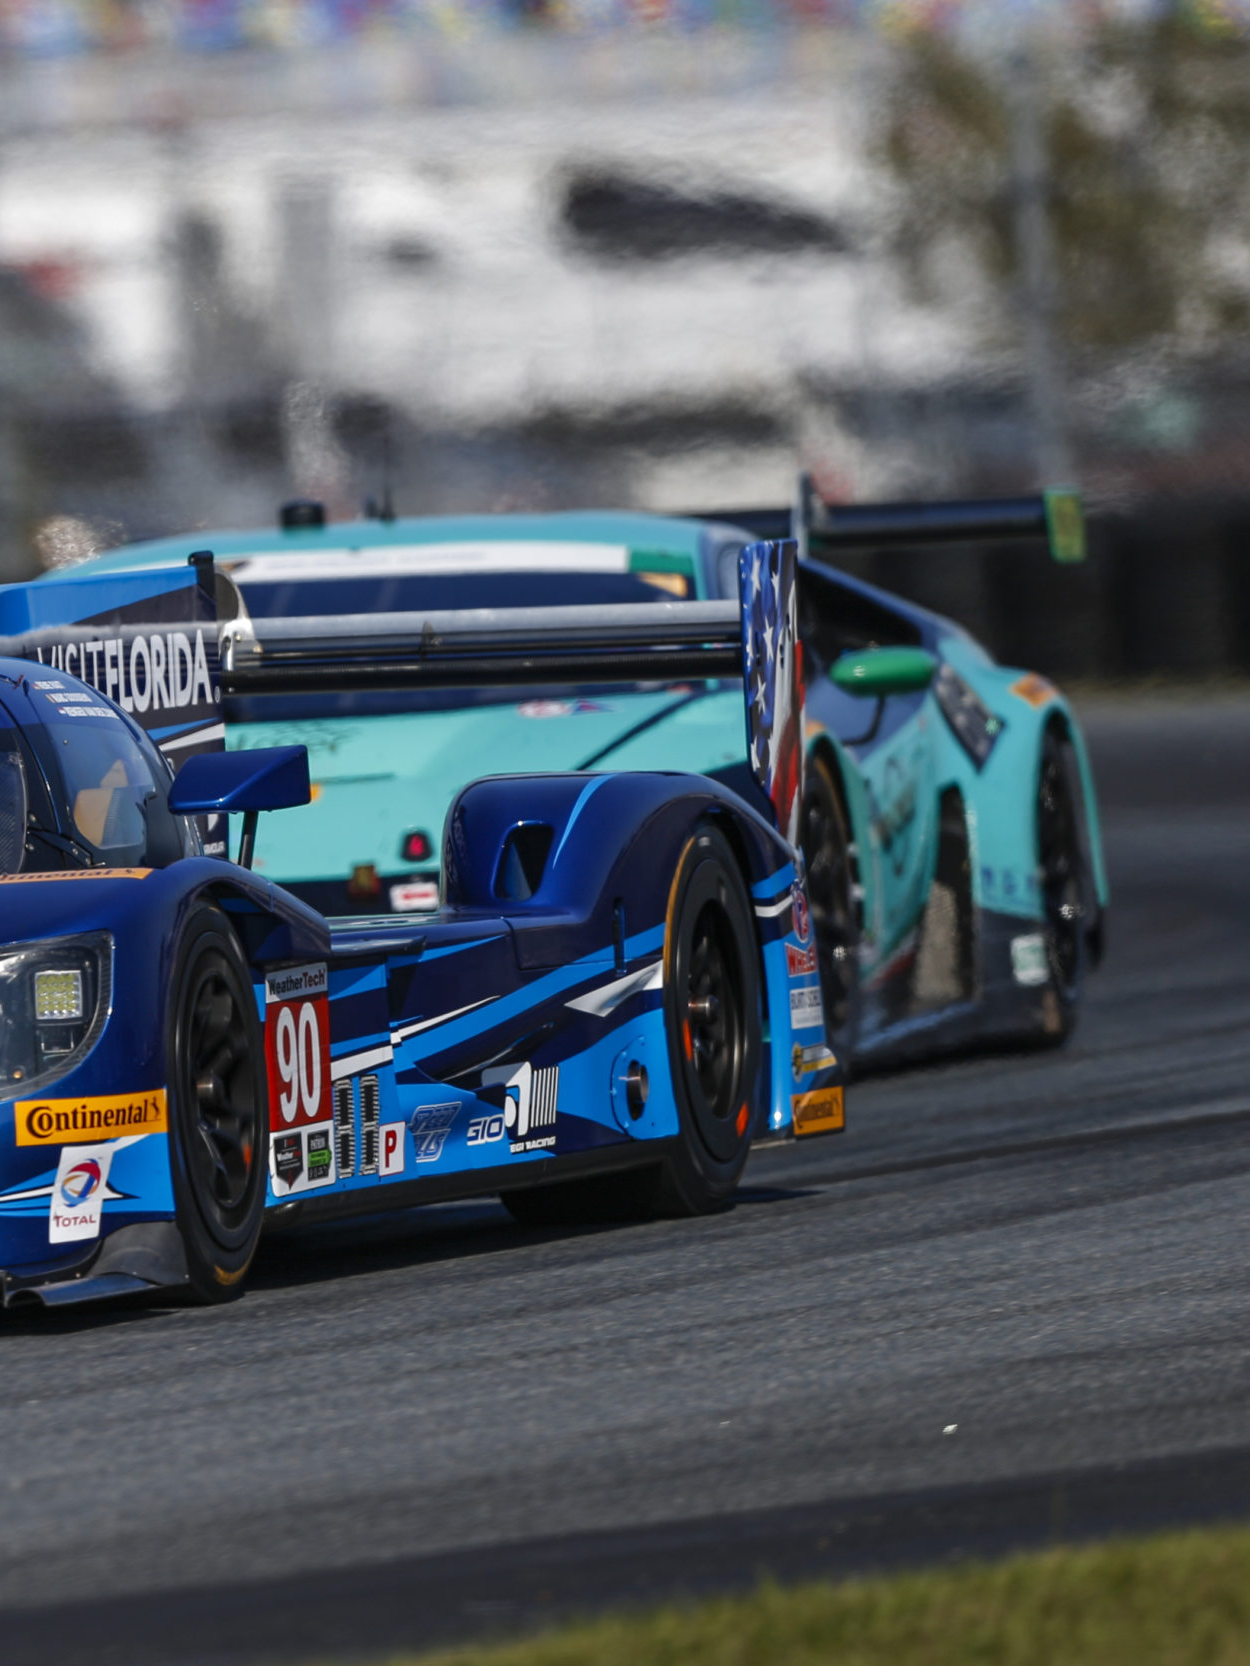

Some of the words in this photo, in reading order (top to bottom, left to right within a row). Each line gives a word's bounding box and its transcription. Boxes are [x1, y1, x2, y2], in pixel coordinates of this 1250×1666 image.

[37, 629, 213, 713] ITFLORIDA
[268, 968, 325, 996] WeatherTech
[276, 1002, 321, 1123] 90
[27, 1098, 149, 1138] Continental
[385, 1130, 397, 1168] P
[54, 1213, 97, 1229] TOTAL
